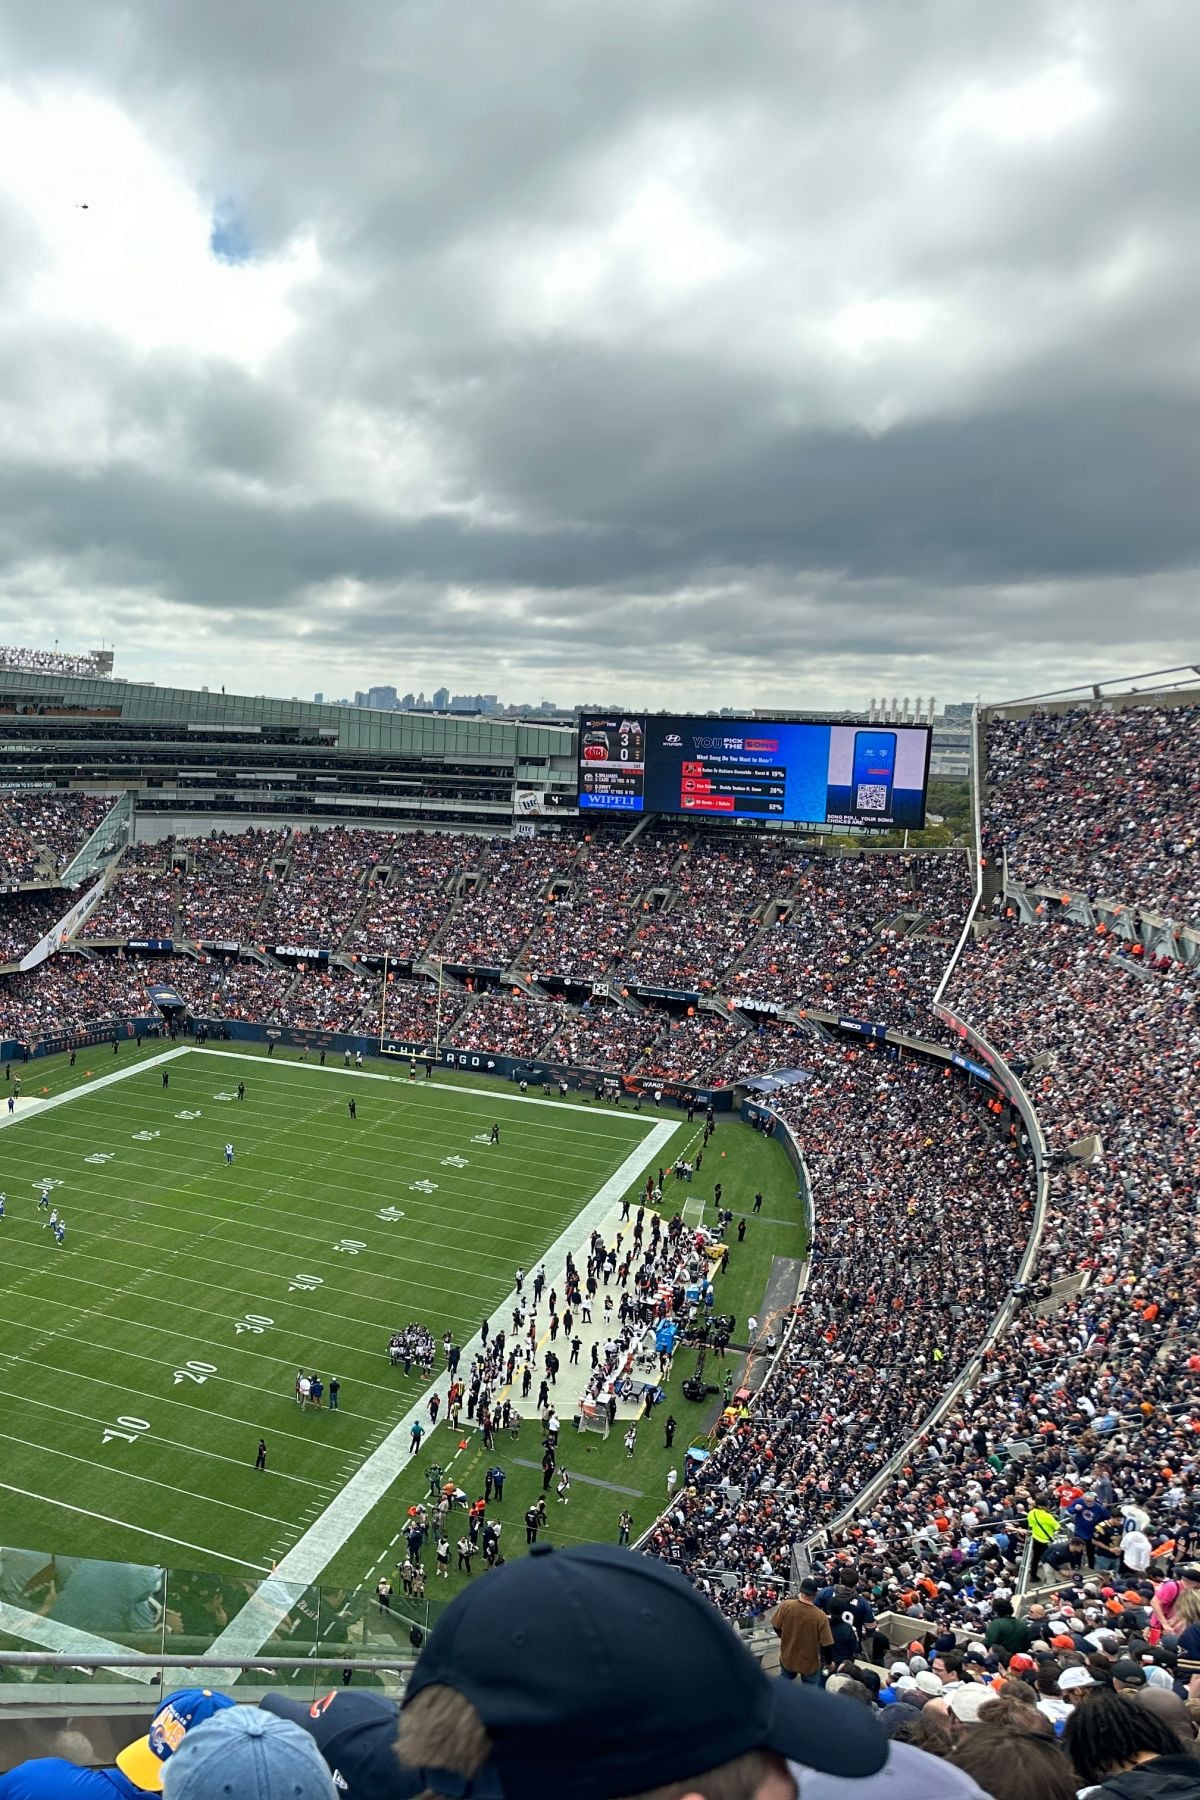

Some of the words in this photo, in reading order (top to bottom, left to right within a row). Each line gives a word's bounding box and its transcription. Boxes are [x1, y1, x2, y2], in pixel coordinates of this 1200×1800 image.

[620, 733, 629, 746] 3
[693, 736, 722, 748] YOU
[620, 748, 629, 760] 0
[588, 794, 635, 805] WIPFLI
[275, 946, 319, 958] DOWN
[596, 984, 608, 995] 25
[733, 998, 784, 1014] DOWN
[335, 1239, 368, 1255] 50
[294, 1274, 324, 1291] 40
[243, 1314, 275, 1334] 30
[183, 1360, 218, 1385] 20
[108, 1415, 151, 1443] 10
